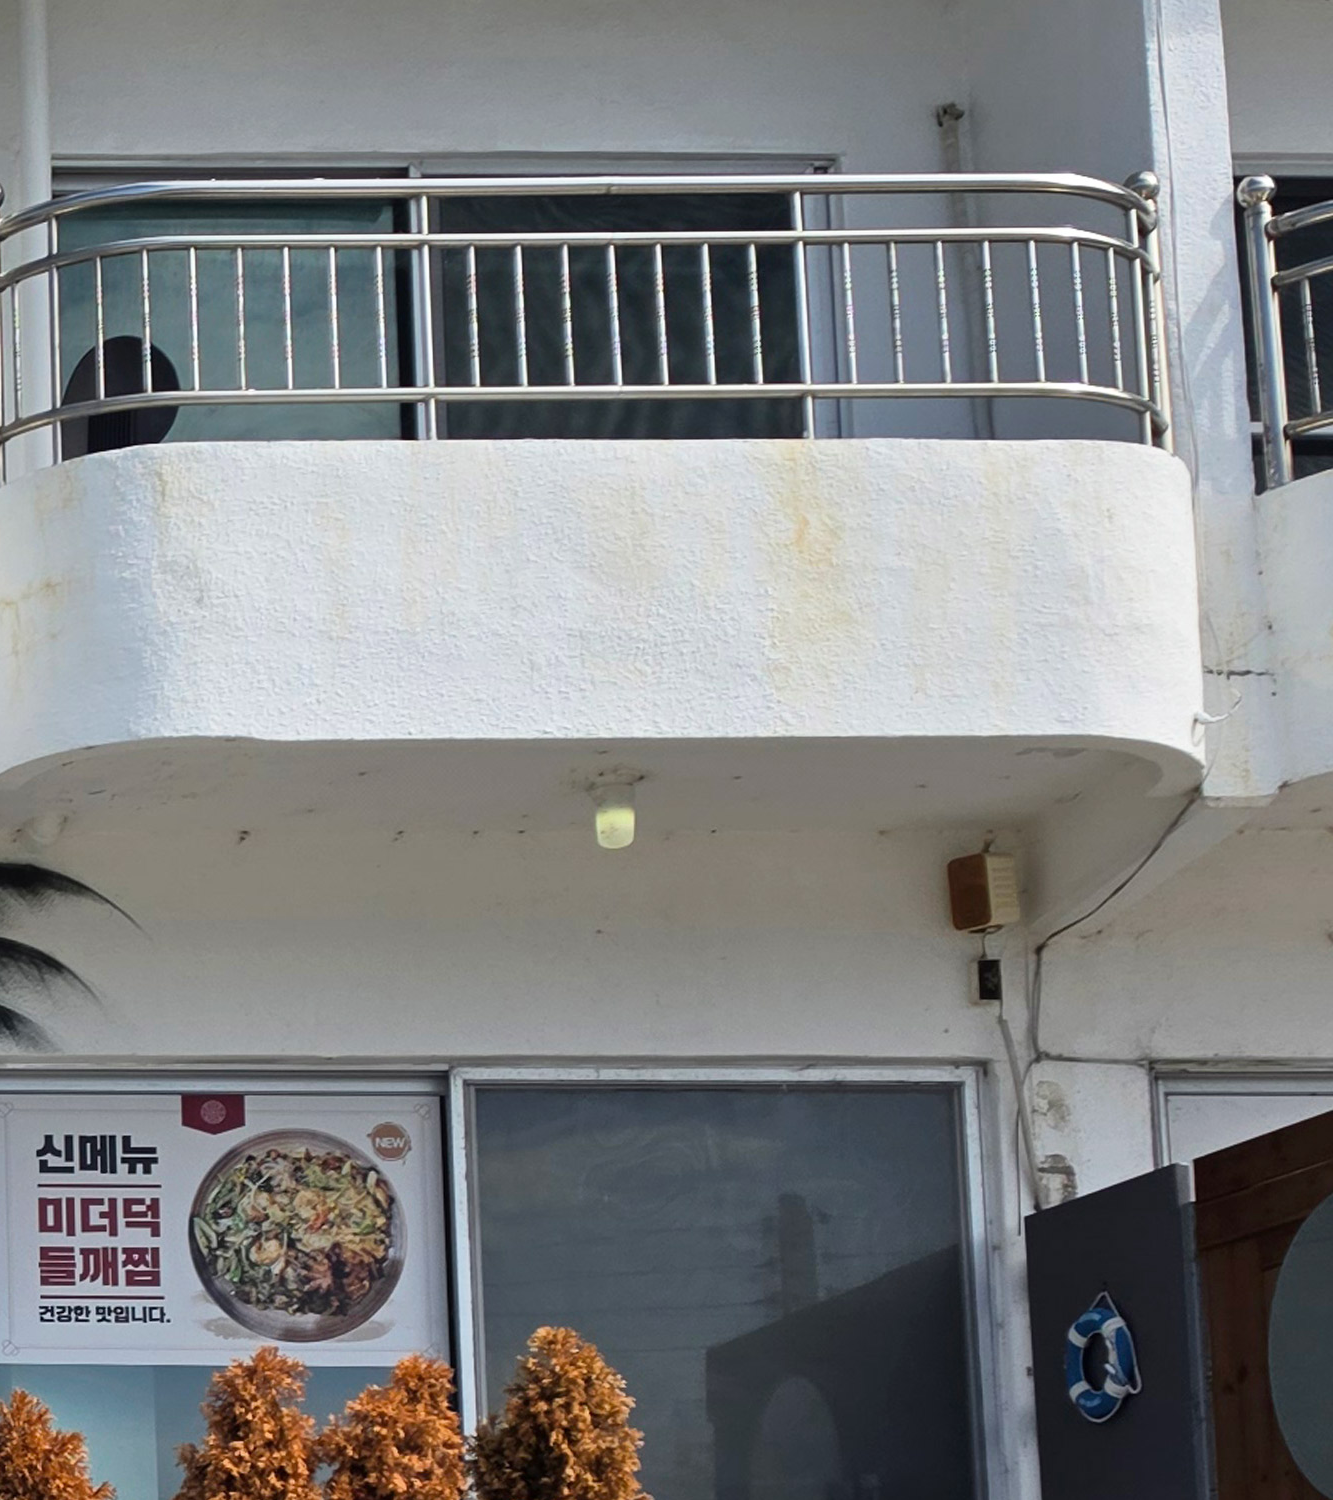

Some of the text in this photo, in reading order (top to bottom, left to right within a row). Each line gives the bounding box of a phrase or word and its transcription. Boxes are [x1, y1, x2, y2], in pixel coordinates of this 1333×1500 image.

[36, 1134, 159, 1175] 신메뉴
[375, 1137, 406, 1149] NEW
[38, 1197, 161, 1237] 미더덕
[38, 1245, 161, 1287] 들깨찜
[38, 1305, 172, 1324] 건강한 맛입니다.
